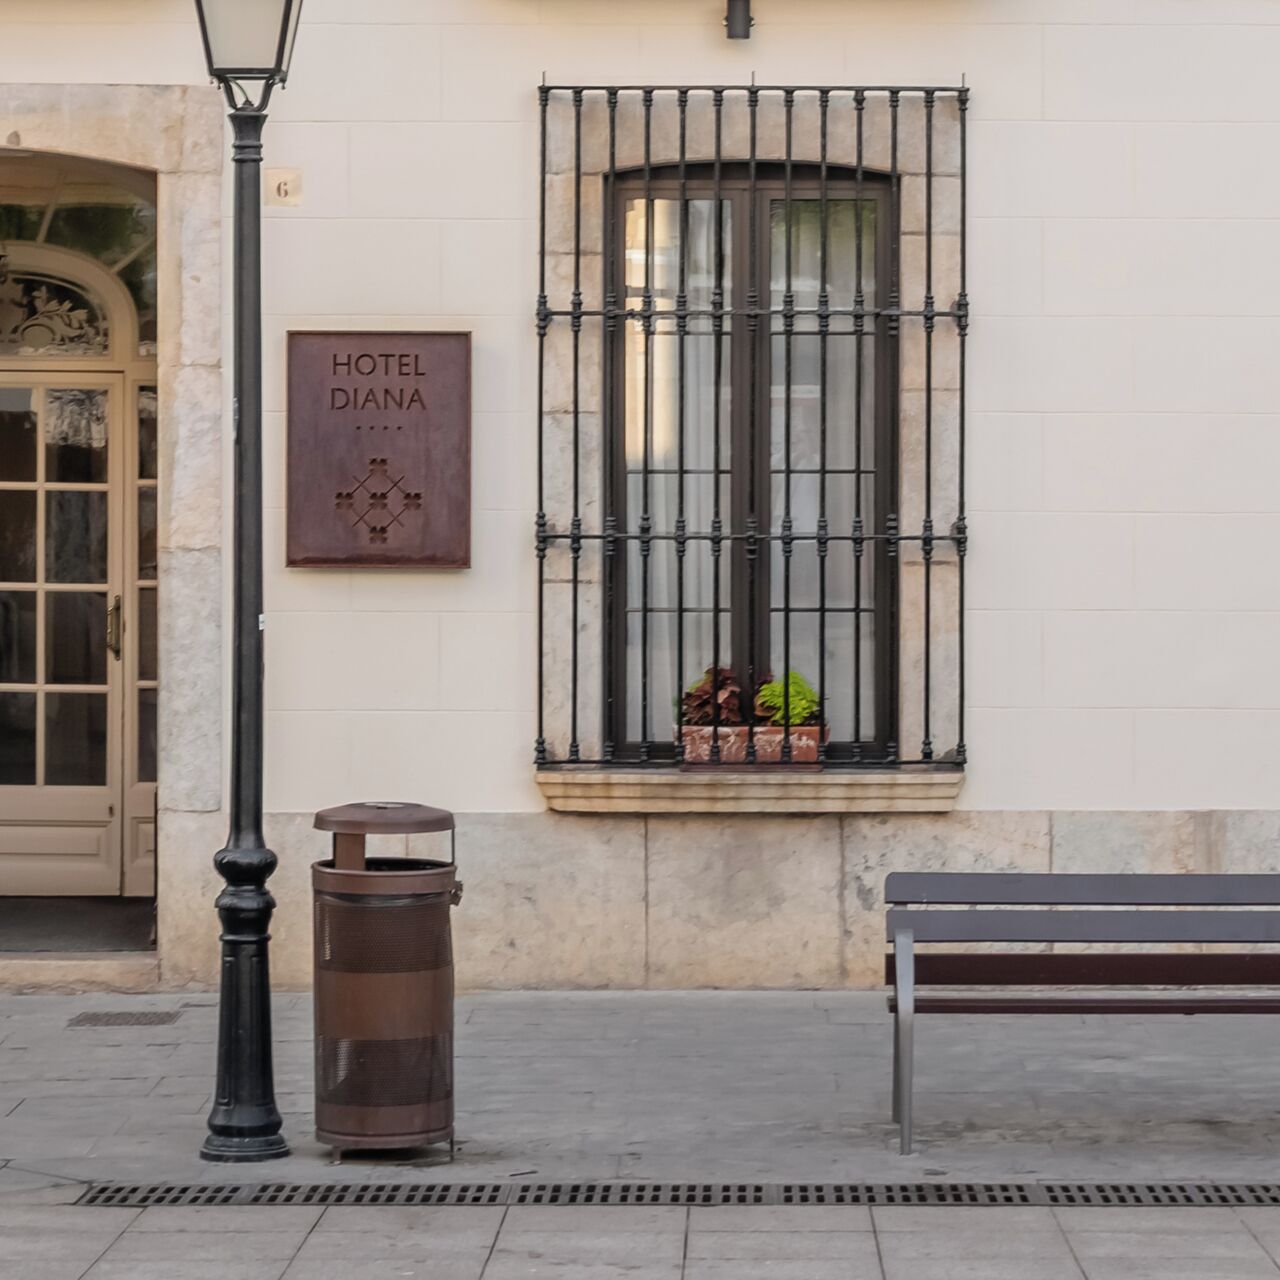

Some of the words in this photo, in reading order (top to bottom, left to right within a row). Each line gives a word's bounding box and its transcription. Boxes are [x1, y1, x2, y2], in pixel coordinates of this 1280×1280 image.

[276, 181, 289, 199] 6
[332, 353, 426, 376] HOTEL
[330, 387, 427, 410] DIANA
